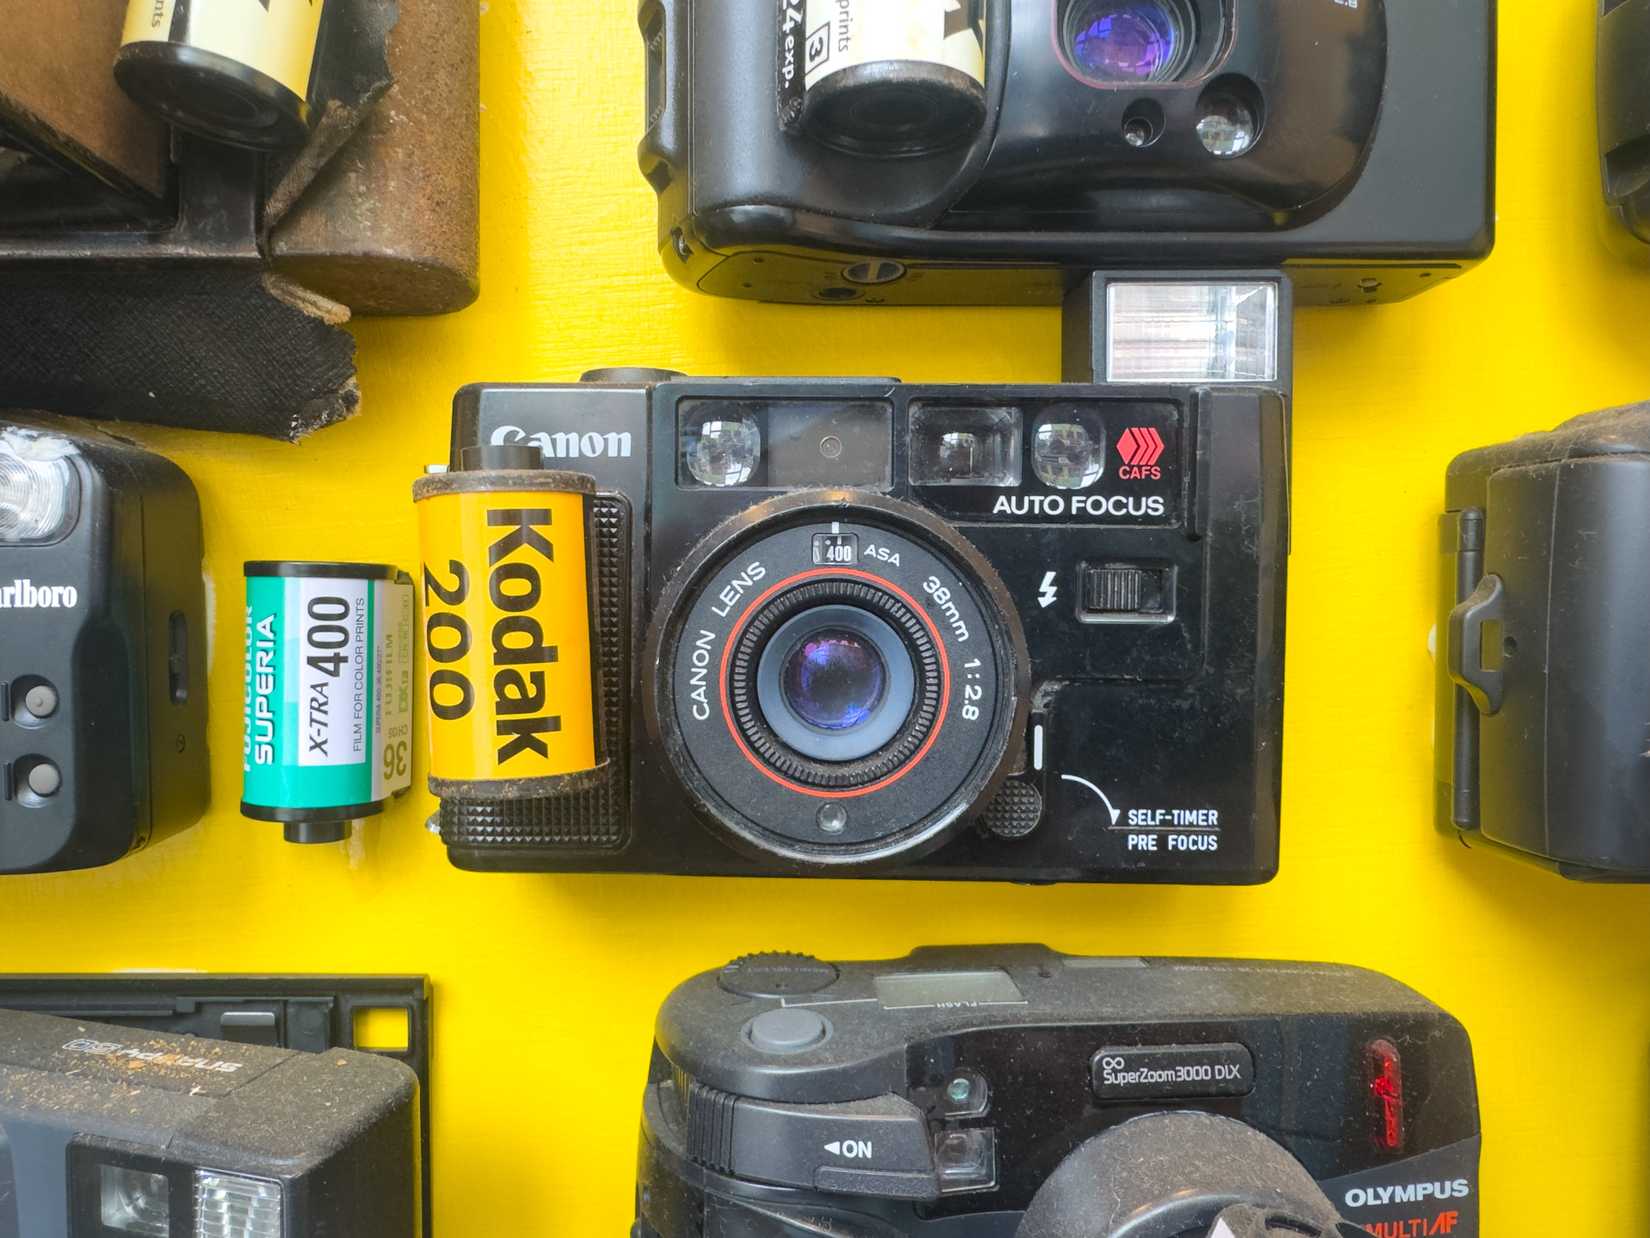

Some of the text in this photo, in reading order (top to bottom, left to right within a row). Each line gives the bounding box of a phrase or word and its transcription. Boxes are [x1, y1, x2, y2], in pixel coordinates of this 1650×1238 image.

[809, 36, 826, 63] 3
[490, 425, 632, 458] Canon
[1118, 466, 1161, 480] CAFS
[991, 495, 1165, 516] AUTO FOCUS
[826, 545, 852, 562] 400
[863, 543, 900, 567] ASA
[0, 579, 77, 608] rlboro
[424, 558, 475, 722] 200
[486, 507, 562, 766] Kodak
[690, 561, 767, 721] CANON LENS
[922, 575, 983, 721] 38mm 1:2.8
[255, 613, 276, 766] SUPERIA
[306, 596, 350, 757] X-TRA 400
[353, 597, 365, 752] FILM FOR COLOR PRINTS
[383, 740, 408, 781] 36
[1128, 809, 1219, 825] SELF-TIMER
[1128, 834, 1218, 850] PRE FOCUS
[1214, 1064, 1242, 1079] DLX
[842, 1139, 873, 1159] ON
[1344, 1178, 1470, 1208] OLYMPUS
